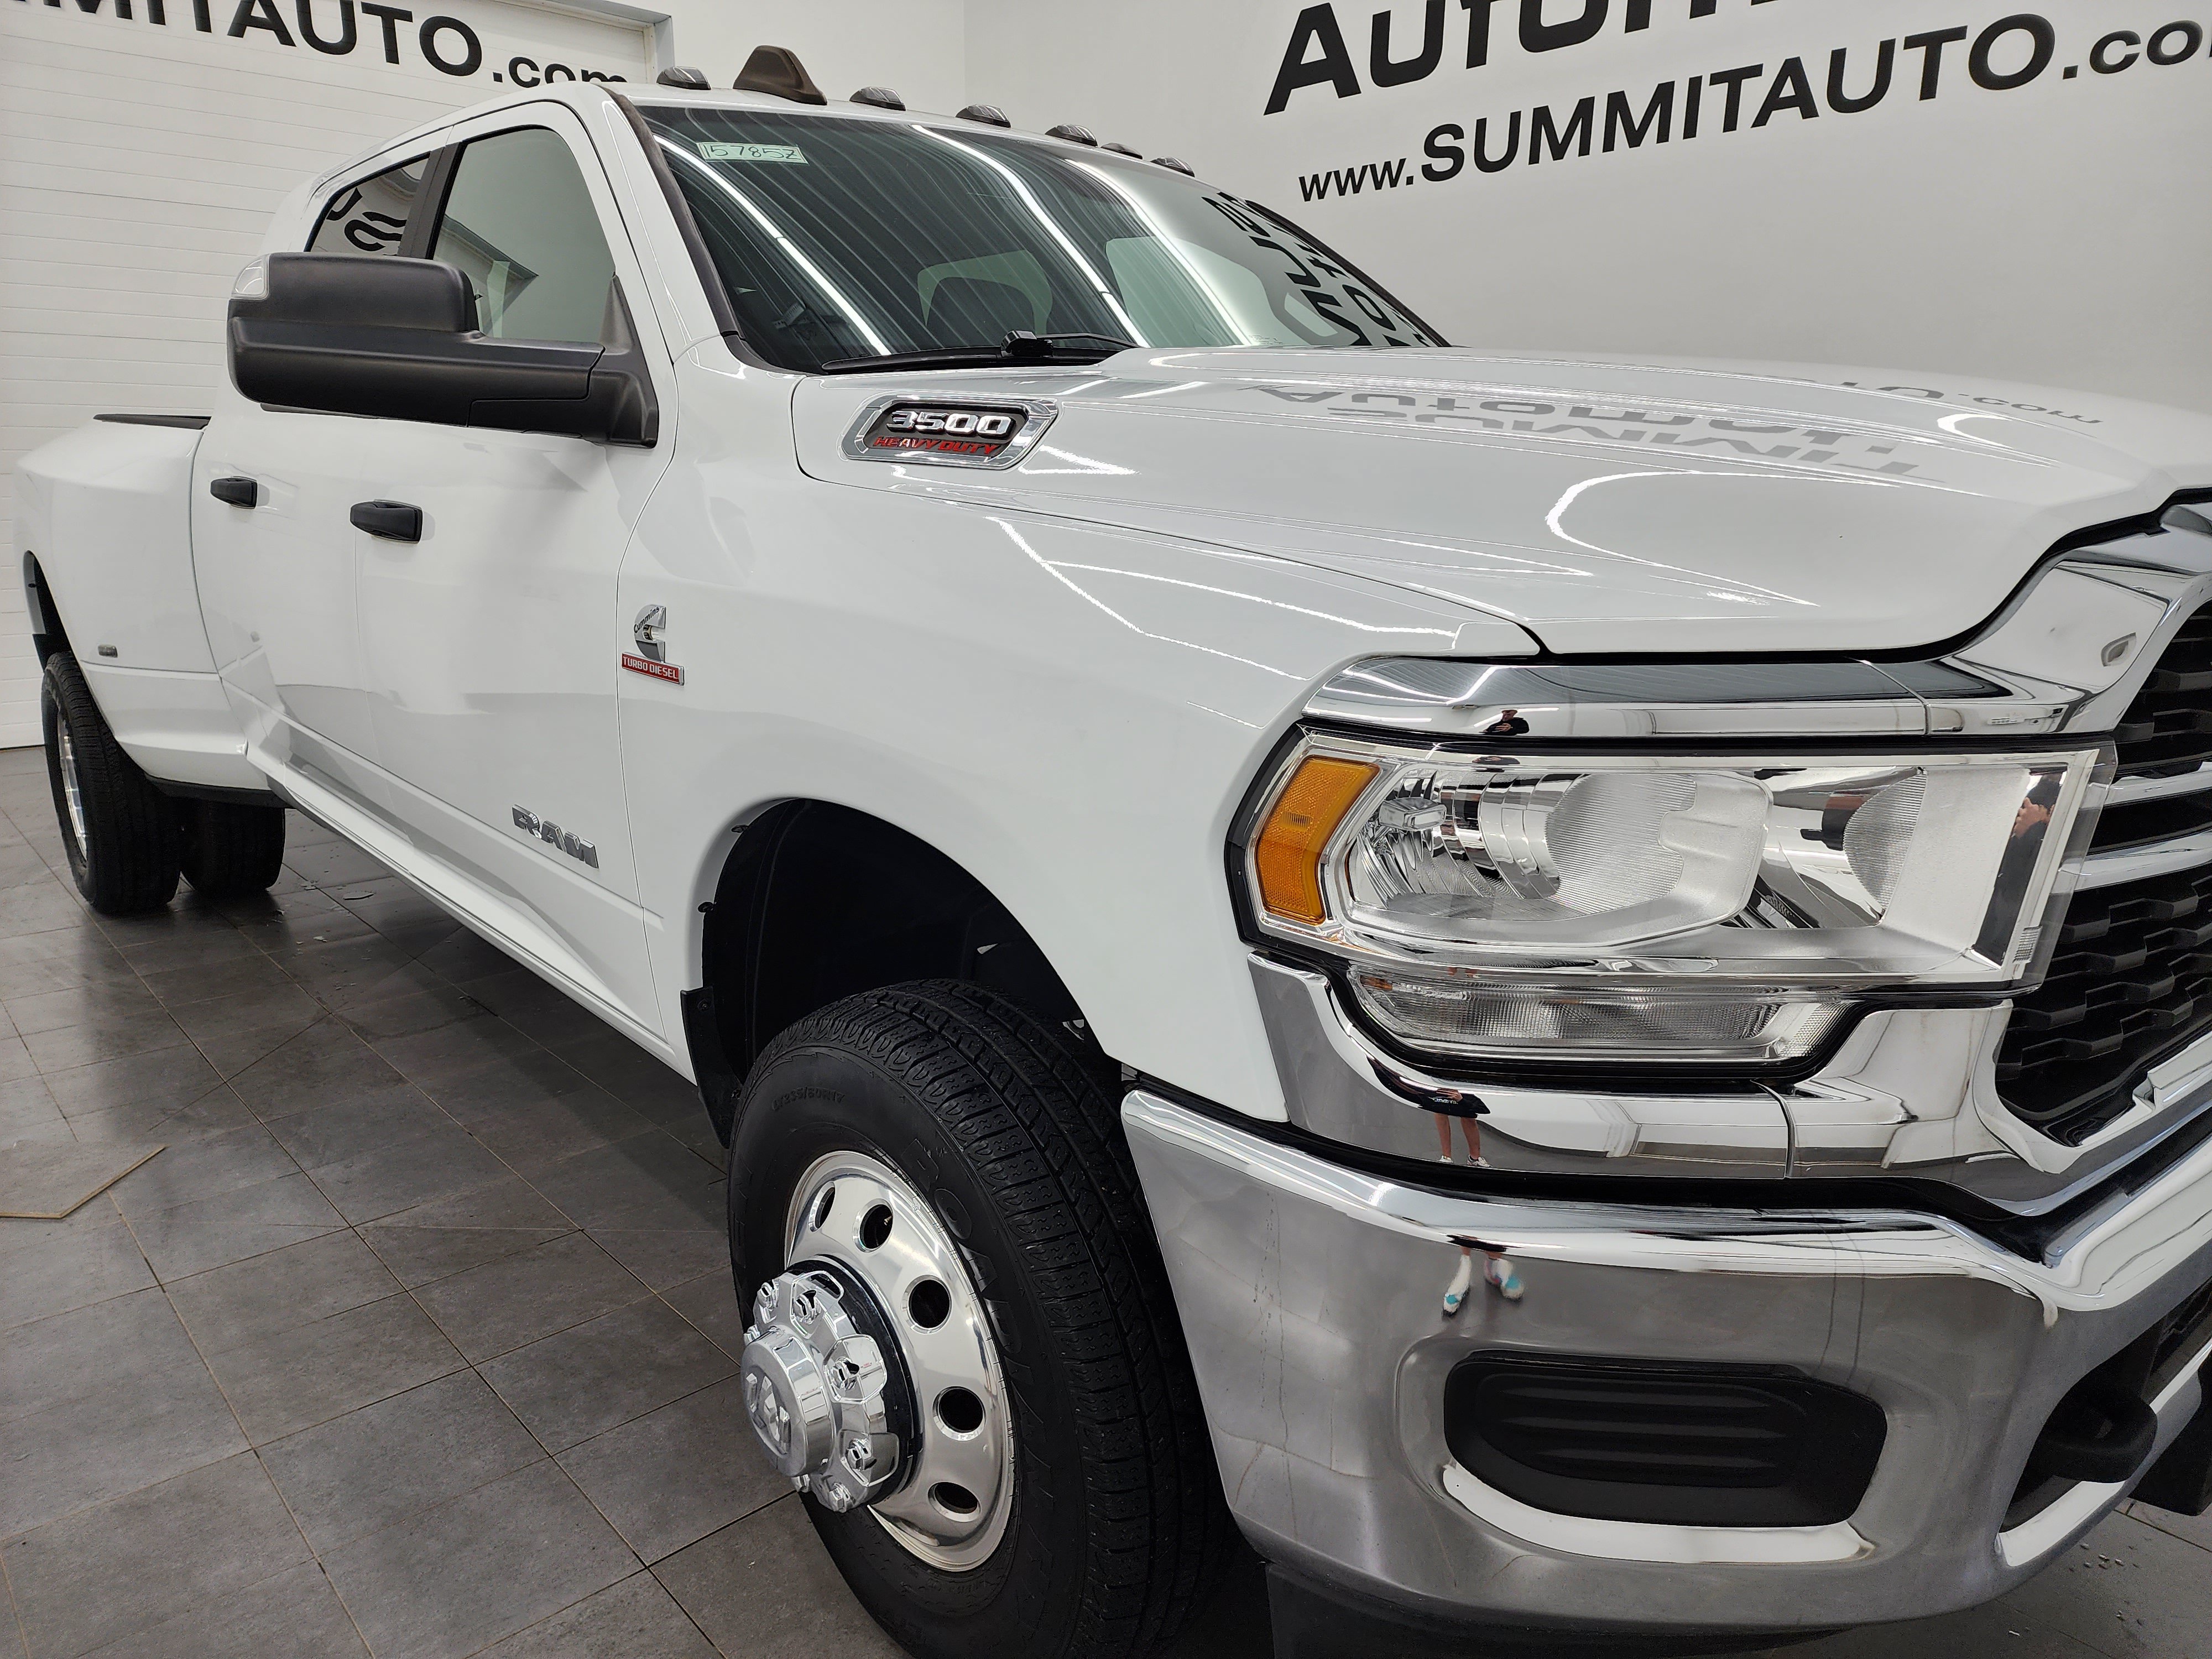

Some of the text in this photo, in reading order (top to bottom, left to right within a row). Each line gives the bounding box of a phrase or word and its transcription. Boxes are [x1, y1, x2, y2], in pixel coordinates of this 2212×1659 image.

[1298, 13, 2212, 202] www.SUMMITAUTO.co
[886, 410, 1013, 438] 3500
[634, 606, 660, 633] Cummins
[623, 656, 679, 679] TURBO DIESEL
[512, 805, 599, 868] RAM
